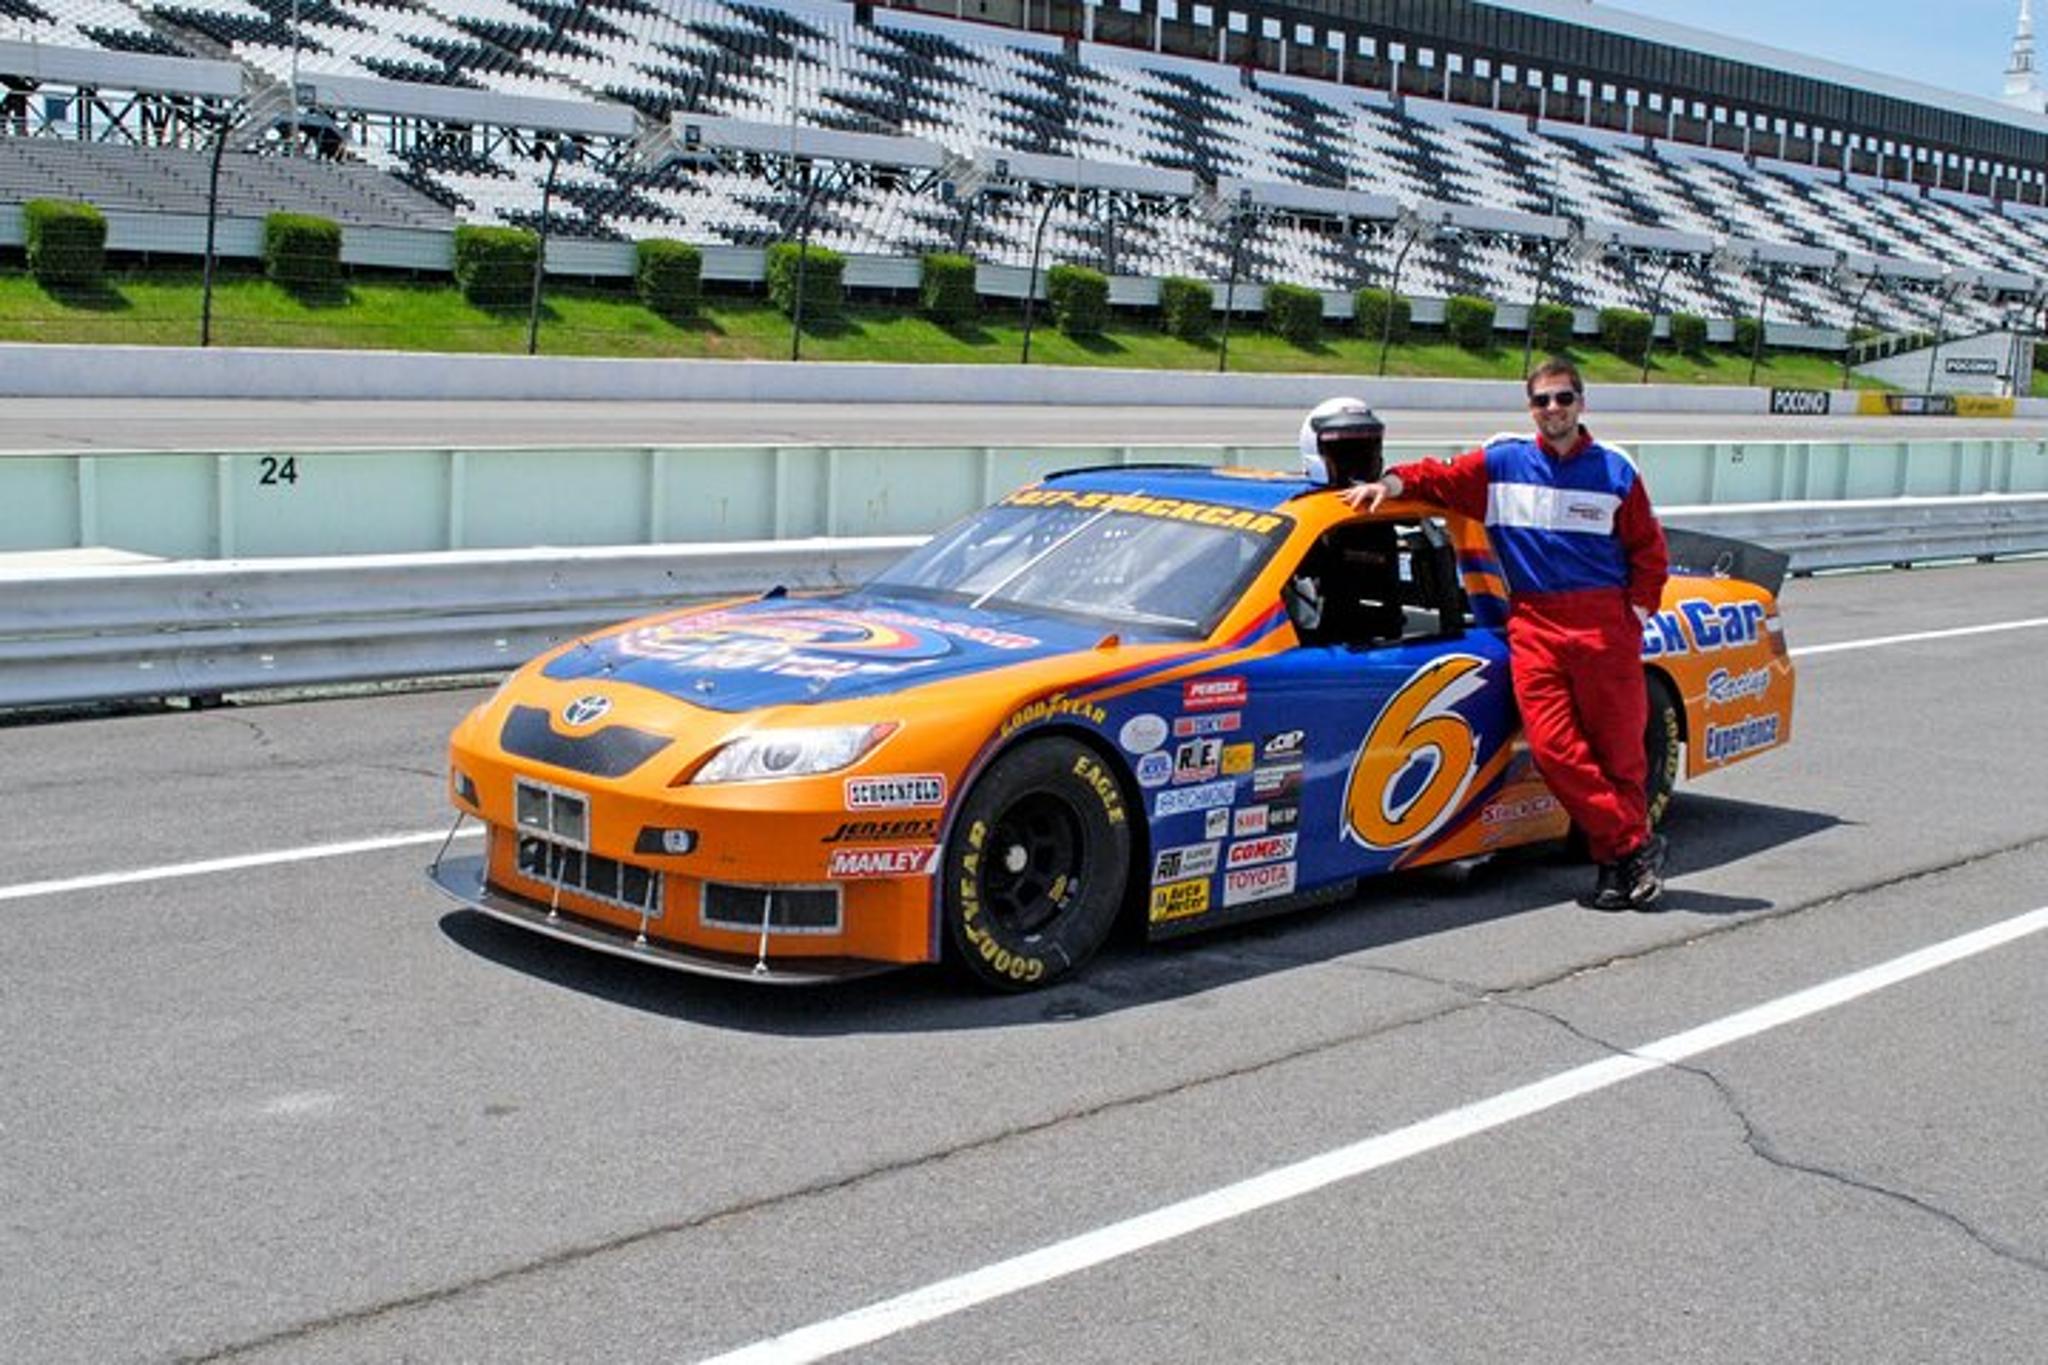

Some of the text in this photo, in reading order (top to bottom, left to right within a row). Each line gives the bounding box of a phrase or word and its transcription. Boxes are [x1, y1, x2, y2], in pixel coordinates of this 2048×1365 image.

[1948, 361, 1995, 371] POCONO
[1775, 391, 1825, 413] POCONO
[259, 455, 298, 485] 24
[1681, 600, 1764, 650] Car
[1708, 670, 1768, 701] Racing
[1341, 654, 1490, 850] 6
[1706, 716, 1778, 760] Experience
[852, 781, 940, 802] SCHOENFELD
[1073, 755, 1125, 825] EAGLE
[833, 850, 922, 873] MANLEY
[1228, 866, 1288, 891] TOYOTA
[960, 820, 1045, 982] GOODYEAR
